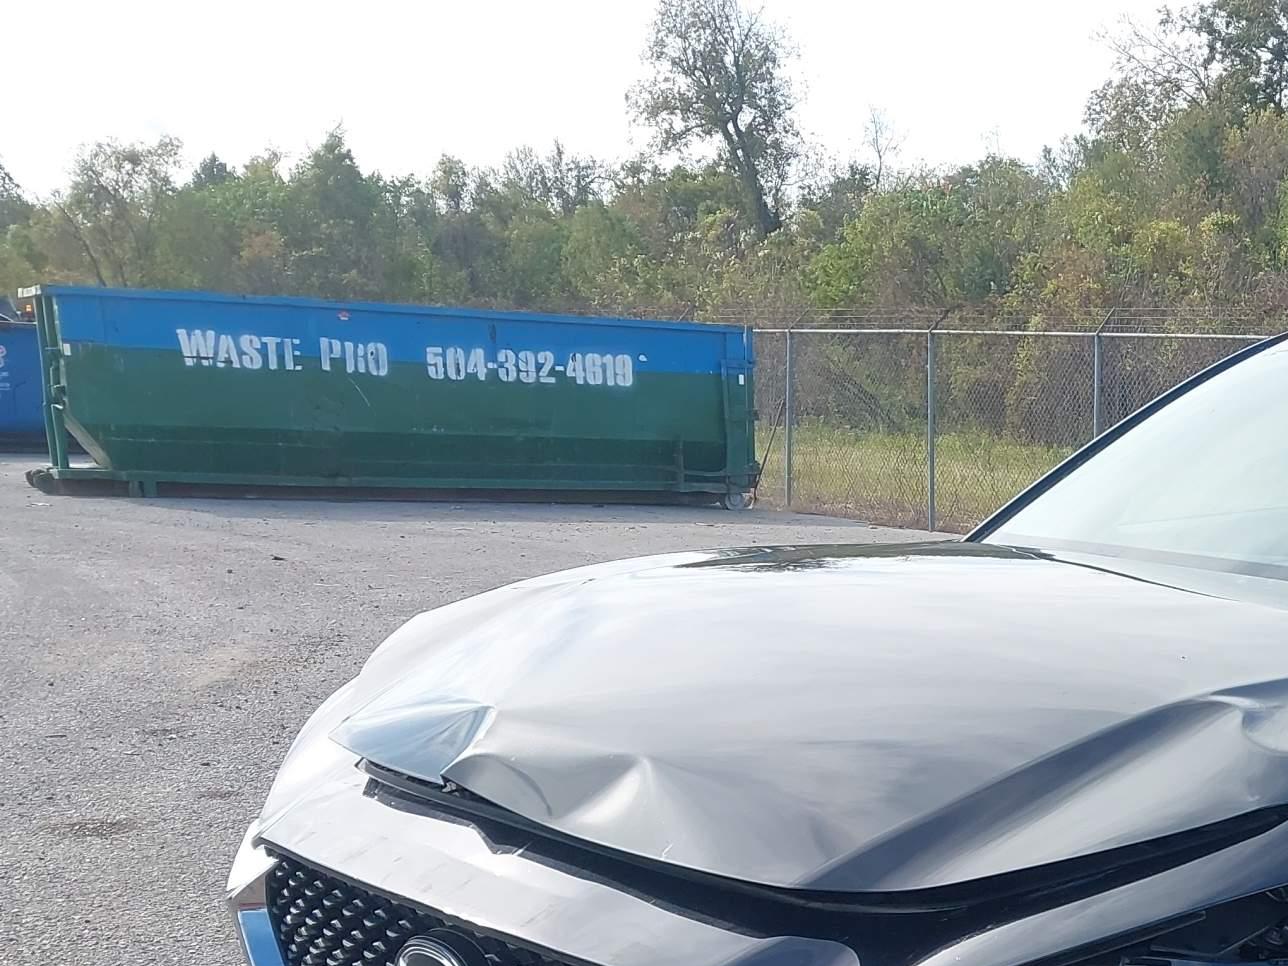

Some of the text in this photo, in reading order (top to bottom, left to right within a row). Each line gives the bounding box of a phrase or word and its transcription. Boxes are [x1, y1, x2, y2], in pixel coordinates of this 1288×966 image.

[176, 328, 633, 387] WASTE PRO 504-392-4619
